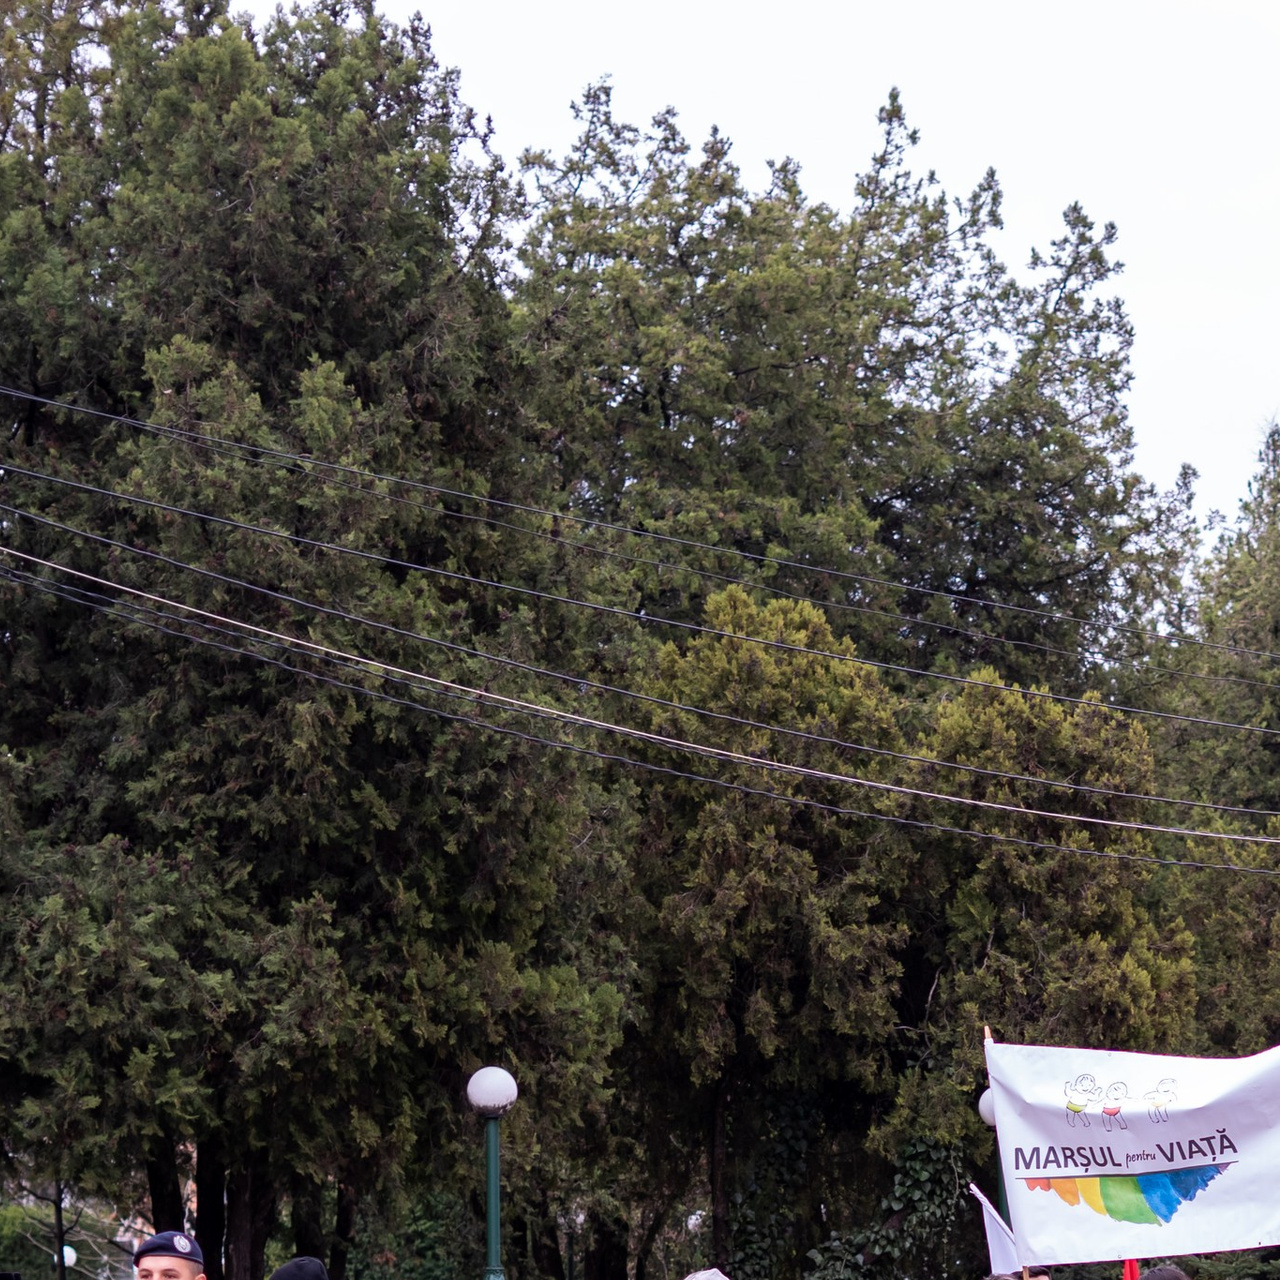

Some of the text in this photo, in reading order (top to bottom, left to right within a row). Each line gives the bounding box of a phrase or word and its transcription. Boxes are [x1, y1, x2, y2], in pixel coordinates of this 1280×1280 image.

[1015, 1128, 1238, 1173] MARȘUL pentru VIAȚĂ
